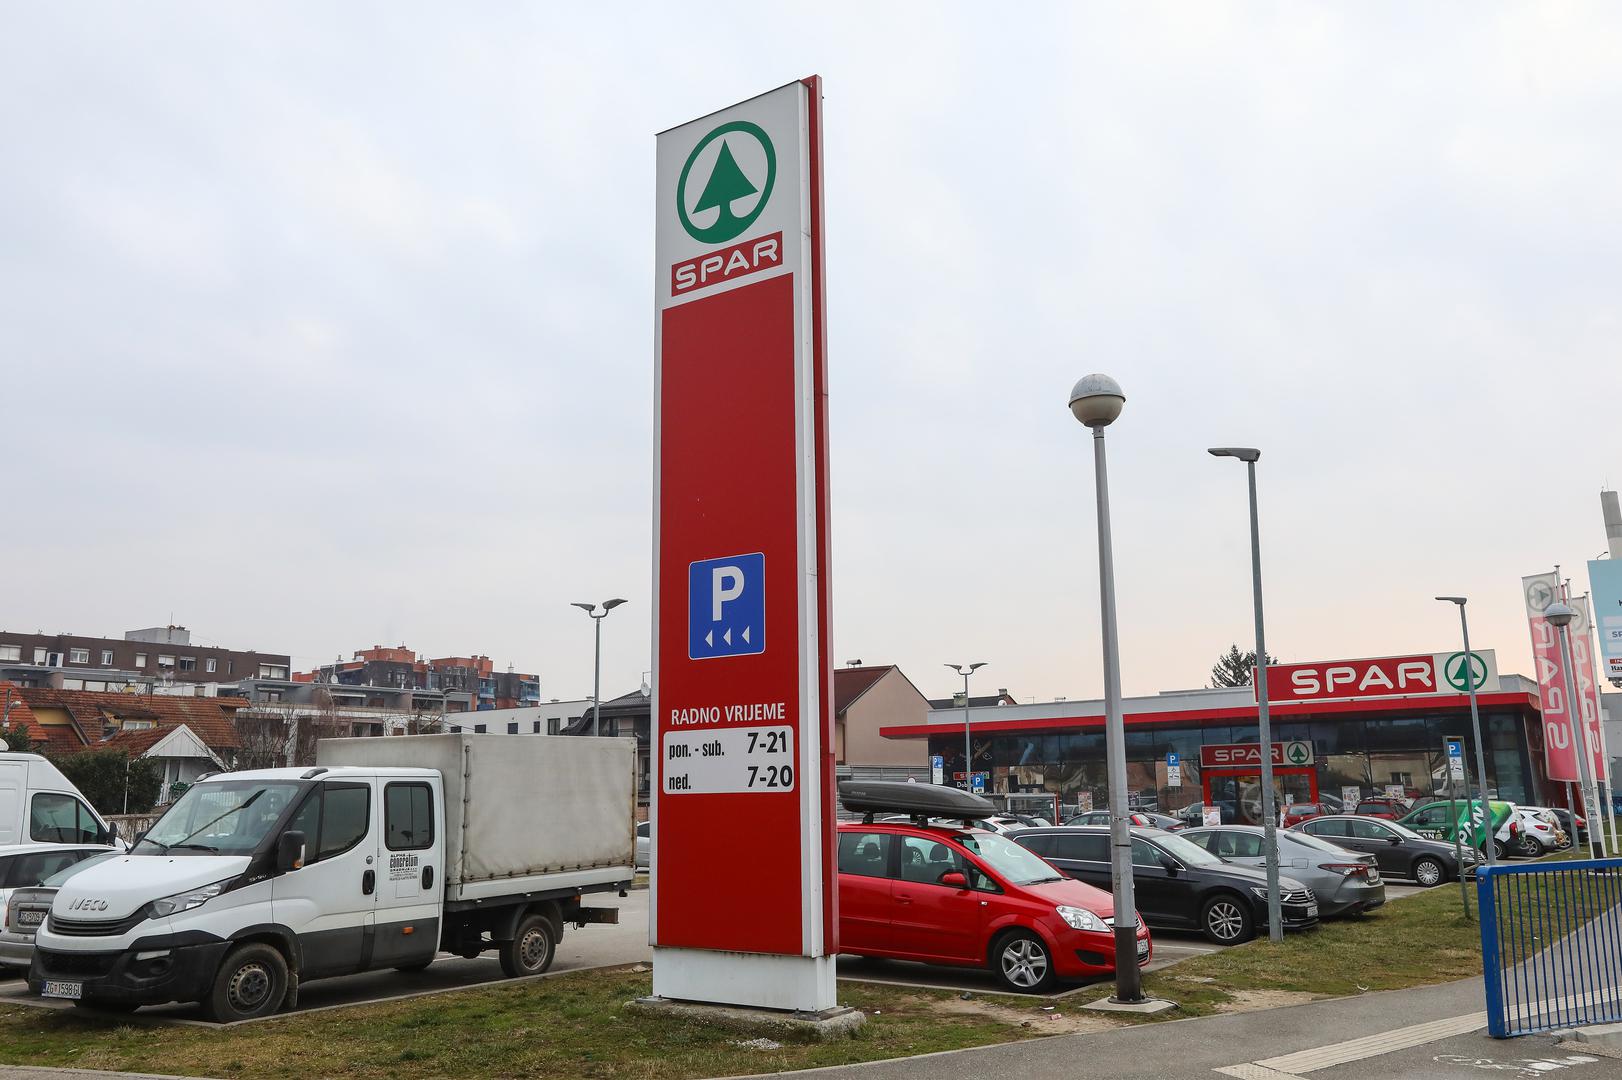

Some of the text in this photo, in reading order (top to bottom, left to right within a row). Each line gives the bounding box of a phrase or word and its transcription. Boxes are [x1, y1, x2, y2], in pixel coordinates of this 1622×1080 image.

[675, 238, 778, 290] SPAR
[712, 565, 745, 622] P
[1291, 661, 1433, 695] SPAR
[671, 702, 786, 725] RADNO VRIJEME
[668, 743, 692, 760] pon.
[702, 740, 725, 757] sub.
[747, 730, 787, 754] 7-21
[1214, 748, 1280, 762] SPAR
[668, 765, 793, 790] ned. 7-20
[975, 777, 981, 786] P
[69, 898, 109, 911] IVECO
[47, 982, 54, 994] ZG
